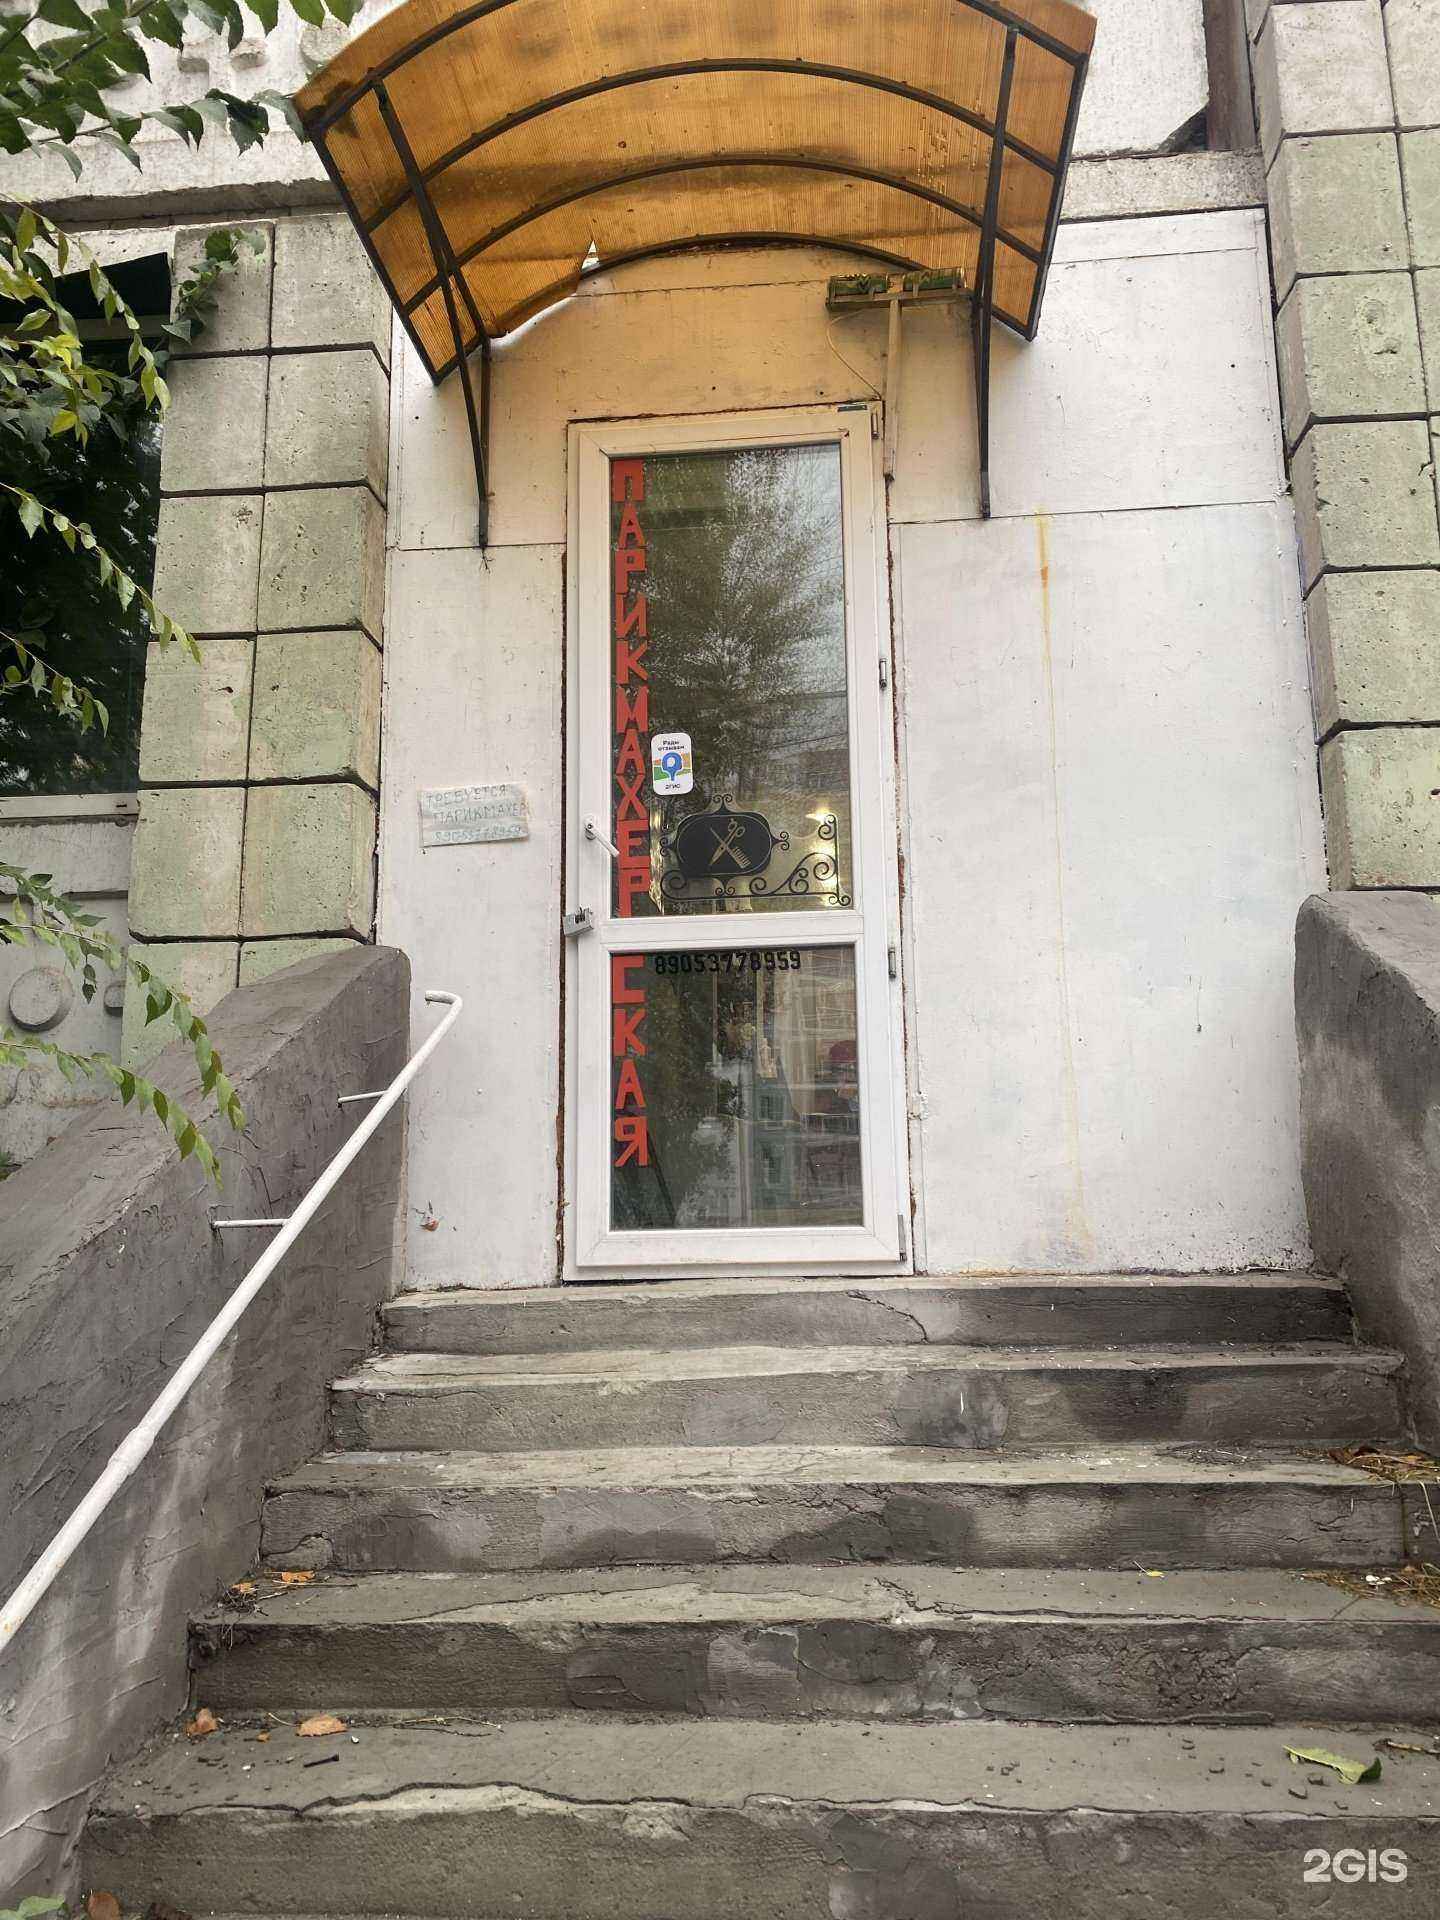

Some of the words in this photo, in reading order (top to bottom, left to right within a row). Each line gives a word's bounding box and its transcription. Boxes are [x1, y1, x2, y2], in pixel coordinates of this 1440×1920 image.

[425, 784, 507, 808] ТРЕБУЕТСЯ
[432, 801, 528, 825] ПАРИКМАХЕР
[655, 950, 801, 974] 89053778959
